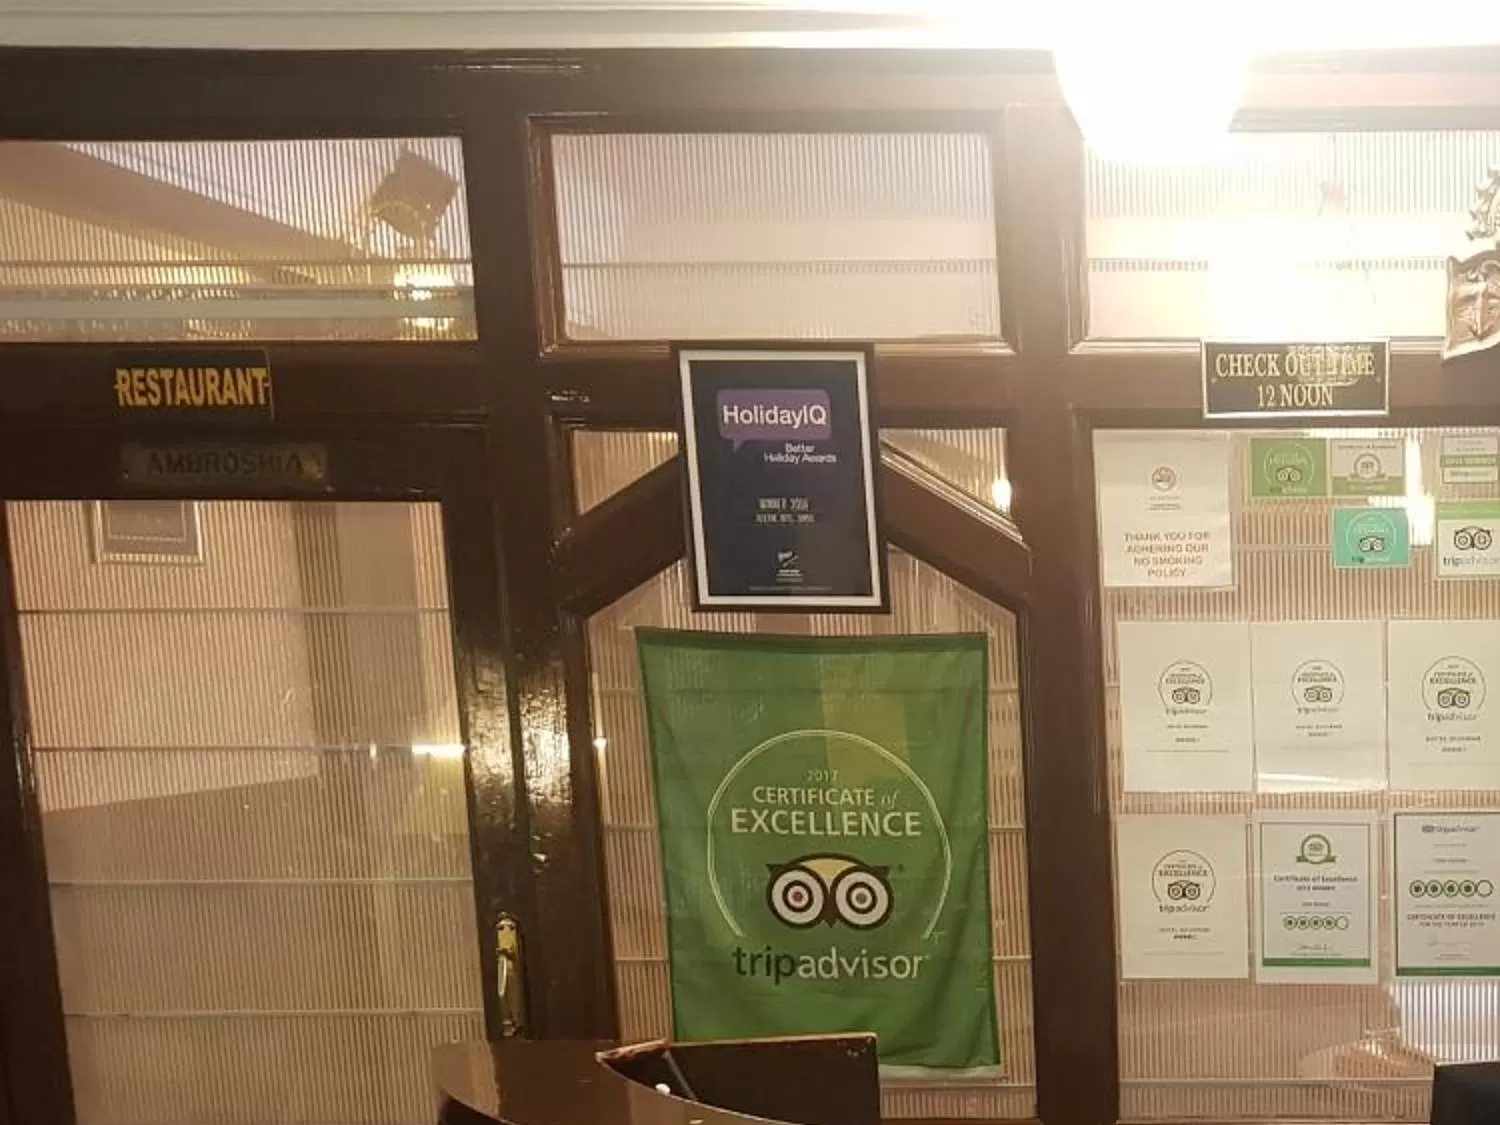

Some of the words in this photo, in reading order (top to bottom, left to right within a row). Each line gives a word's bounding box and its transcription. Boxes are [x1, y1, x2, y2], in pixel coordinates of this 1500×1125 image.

[1215, 353, 1281, 377] CHECK
[115, 367, 268, 407] RESTAURANT
[1257, 384, 1276, 408] 12
[1279, 383, 1334, 408] NOON
[722, 403, 828, 429] HolidayIQ
[147, 450, 305, 476] AMBROSHIA
[1124, 531, 1161, 542] THANK
[1163, 531, 1186, 541] YOU
[1188, 531, 1210, 541] FOR
[1185, 543, 1209, 552] OUR
[1133, 556, 1150, 566] NO
[1152, 555, 1203, 565] SMOKING
[751, 785, 876, 807] CERTIFICATE
[880, 789, 899, 810] of
[730, 807, 923, 837] EXCELLENCE
[732, 945, 924, 987] tripadvisor
